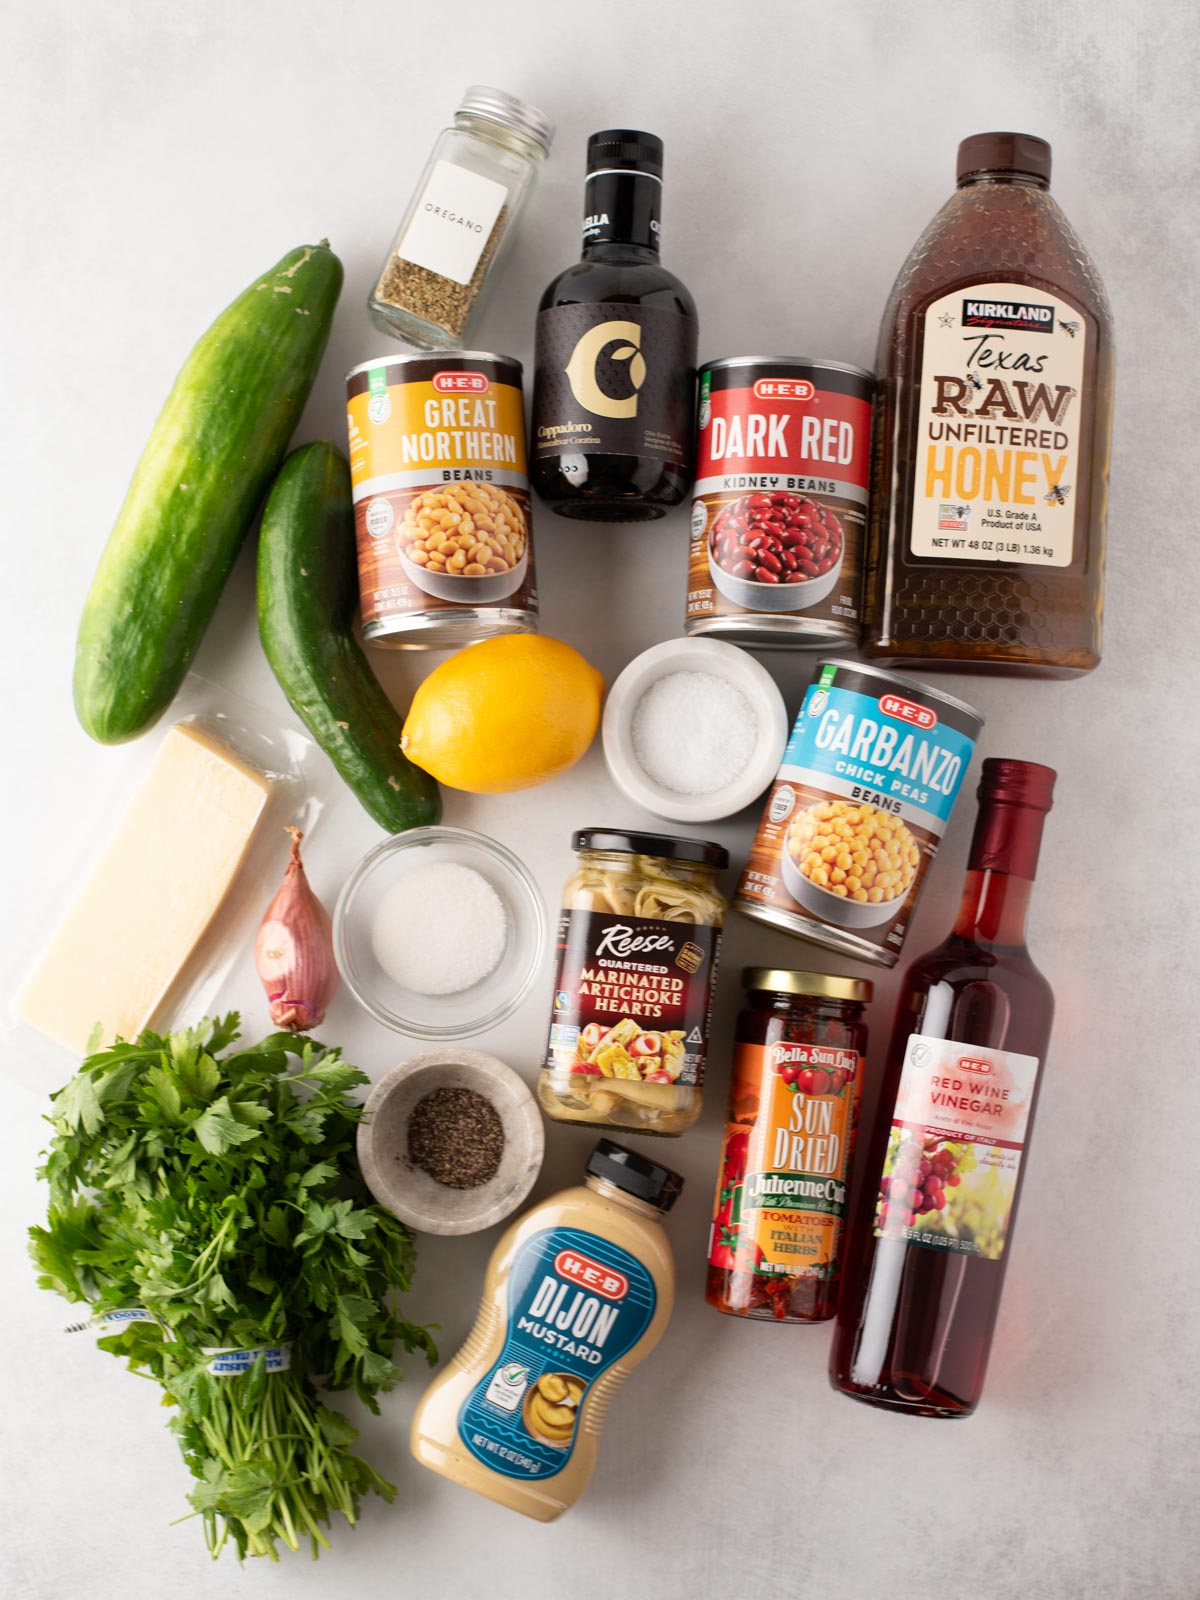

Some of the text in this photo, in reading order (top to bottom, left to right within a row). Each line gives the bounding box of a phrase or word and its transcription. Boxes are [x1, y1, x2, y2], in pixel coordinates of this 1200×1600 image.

[425, 203, 483, 233] OREGANO
[966, 302, 1052, 321] KIRKLAND
[966, 316, 1050, 329] Signature
[962, 334, 1048, 373] Texas
[439, 378, 484, 390] H-E-B
[759, 383, 809, 397] H-E-B
[932, 375, 1075, 424] RAW
[424, 398, 497, 428] GREAT
[401, 432, 517, 464] NORTHERN
[710, 414, 854, 465] DARK RED
[928, 422, 1069, 450] UNFILTERED
[442, 470, 493, 481] BEANS
[723, 477, 836, 493] KIDNEY BEANS
[925, 445, 1068, 507] HONEY
[981, 519, 1042, 531] Product of USA
[987, 509, 1003, 518] U.S.
[1005, 510, 1030, 520] Grade
[932, 538, 1054, 557] NET WT 48 OZ (3 LB) 1.36 kg
[884, 698, 932, 726] H-E-B
[815, 709, 963, 796] GARBANZO
[835, 760, 929, 804] CHICK PEAS
[851, 786, 903, 814] BEANS
[596, 924, 673, 957] Reese
[598, 958, 669, 975] QUARTERED
[580, 967, 684, 992] MARINATED
[578, 981, 683, 1006] ARTICHOKE
[594, 997, 662, 1018] HEARTS
[774, 1046, 808, 1064] Bella
[809, 1048, 834, 1064] Sun
[931, 1076, 1010, 1100] RED WINE
[789, 1093, 834, 1136] SUN
[931, 1092, 1003, 1116] VINEGAR
[925, 1126, 963, 1139] PRODUCT
[964, 1133, 976, 1141] OF
[772, 1127, 840, 1174] DRIED
[762, 1211, 834, 1227] TOMATOES
[783, 1224, 814, 1232] WITH
[770, 1230, 823, 1244] ITALIAN
[773, 1242, 817, 1255] HERBS
[562, 1257, 621, 1293] H-E-B
[528, 1275, 620, 1348] DIJON
[517, 1316, 603, 1366] MUSTARD
[472, 1433, 487, 1447] NET
